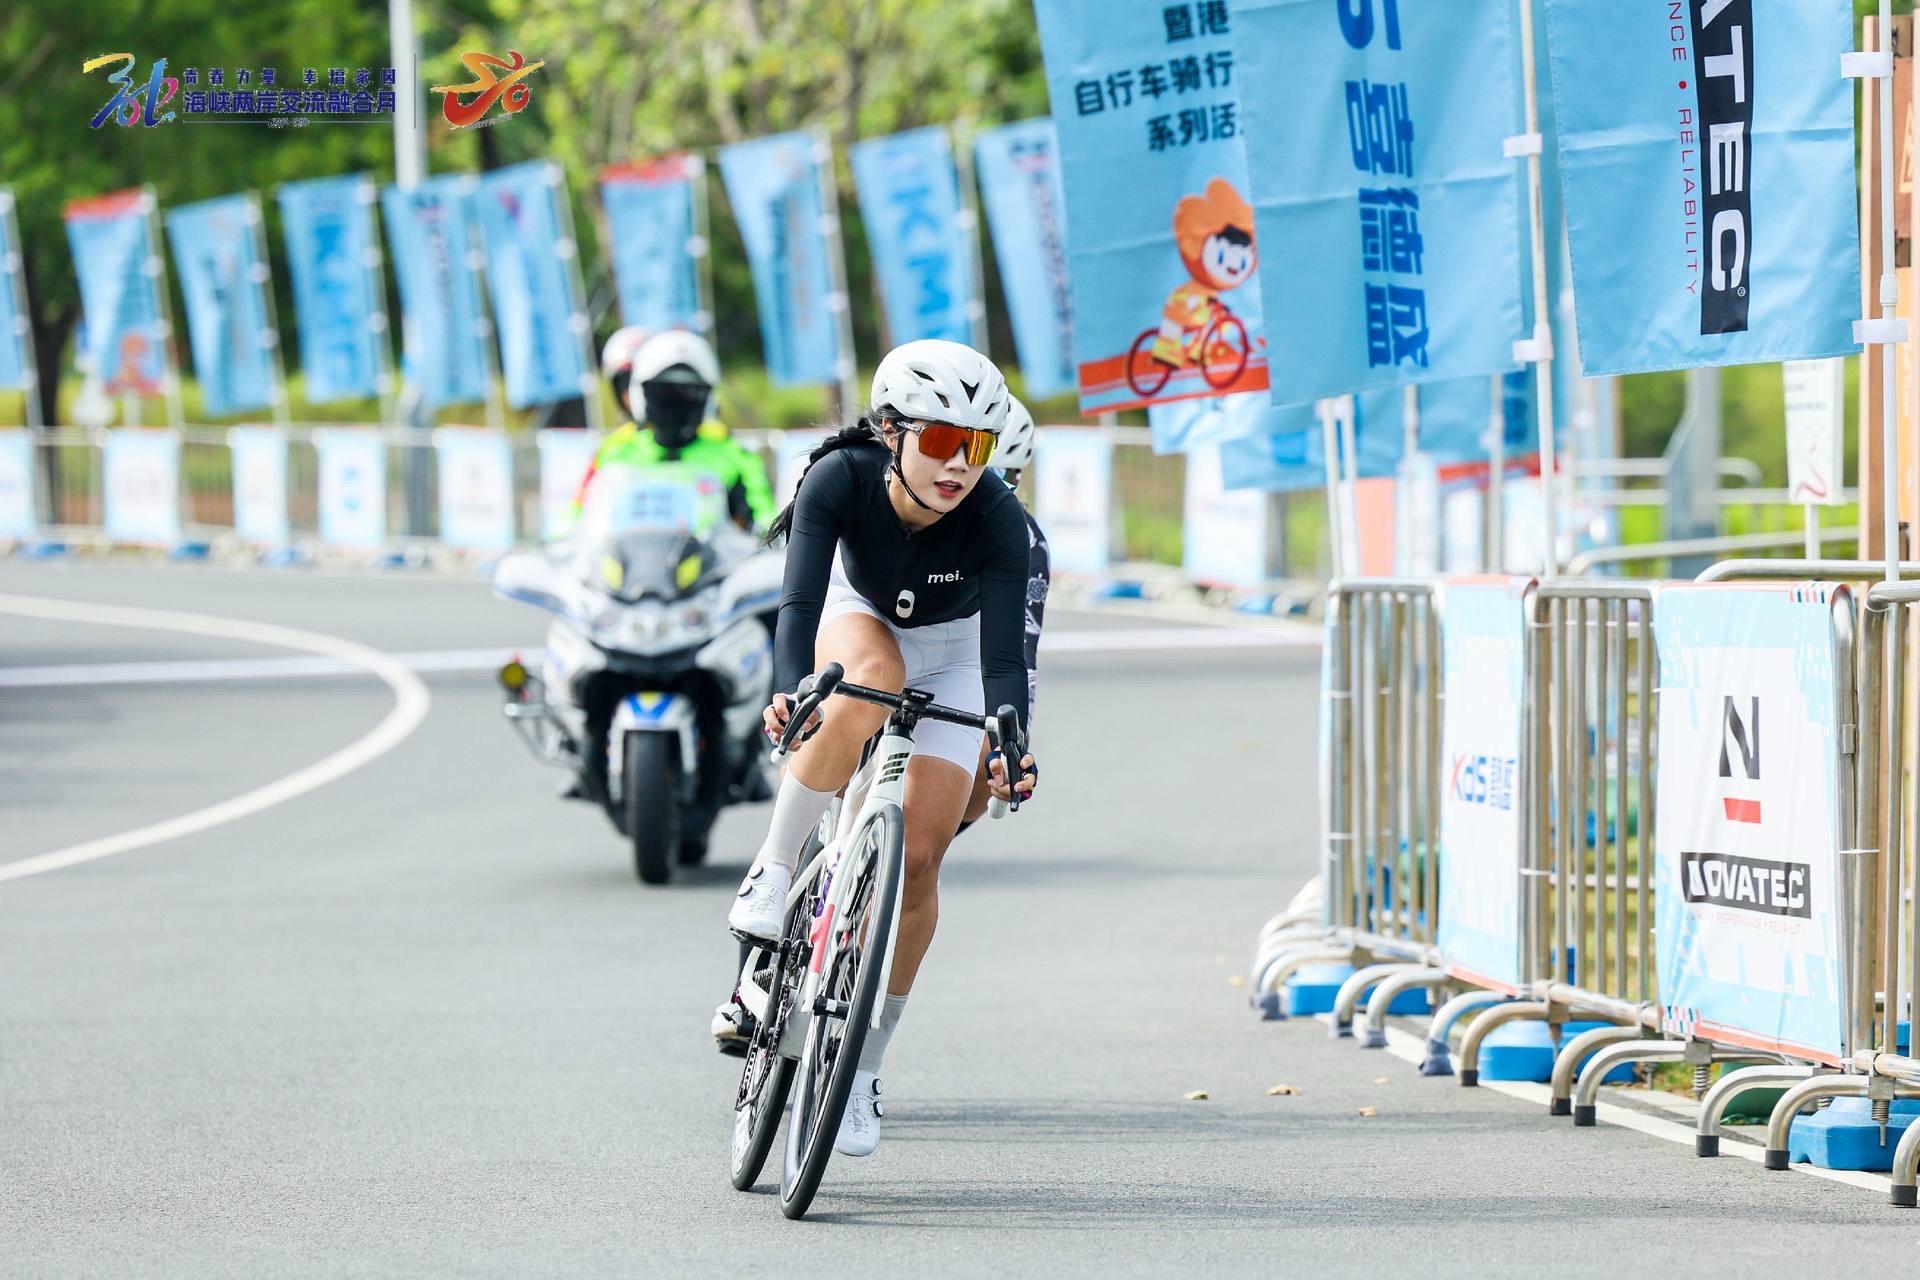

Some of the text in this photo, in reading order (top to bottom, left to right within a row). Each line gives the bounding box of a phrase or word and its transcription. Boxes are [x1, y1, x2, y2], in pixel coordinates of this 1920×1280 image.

[1075, 51, 1233, 117] 自行车骑行
[1146, 102, 1244, 152] 系列活
[1344, 78, 1430, 369] 喜德盛
[1678, 108, 1698, 294] RELIABILITY
[889, 185, 953, 340] KM
[1687, 859, 1805, 909] NOVATEC
